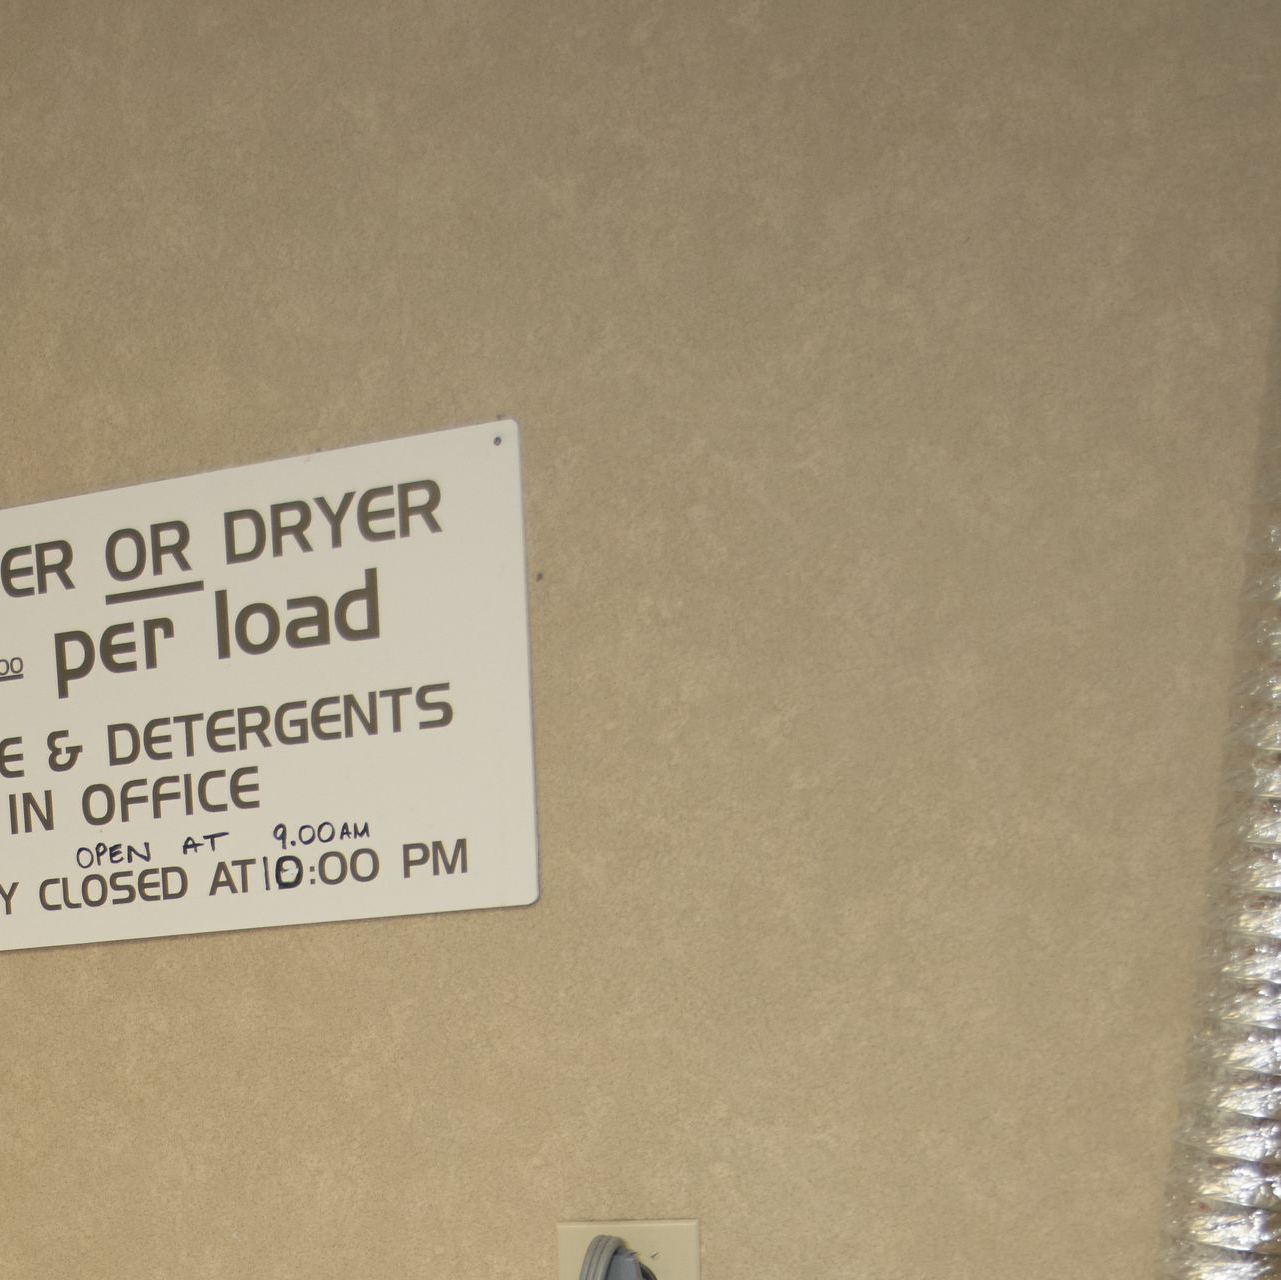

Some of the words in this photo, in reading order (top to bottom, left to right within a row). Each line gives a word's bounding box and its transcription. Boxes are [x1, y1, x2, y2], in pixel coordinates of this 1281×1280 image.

[105, 519, 192, 582] OR
[224, 479, 443, 565] DRYER
[54, 617, 175, 700] per
[214, 567, 381, 660] load
[46, 729, 84, 773] &
[106, 681, 454, 767] DETERGENTS
[8, 789, 55, 835] IN
[81, 765, 261, 827] OFFICE
[38, 865, 189, 912] CLOSED
[402, 837, 468, 879] PM
[76, 841, 152, 870] OPEN
[182, 831, 230, 856] AT
